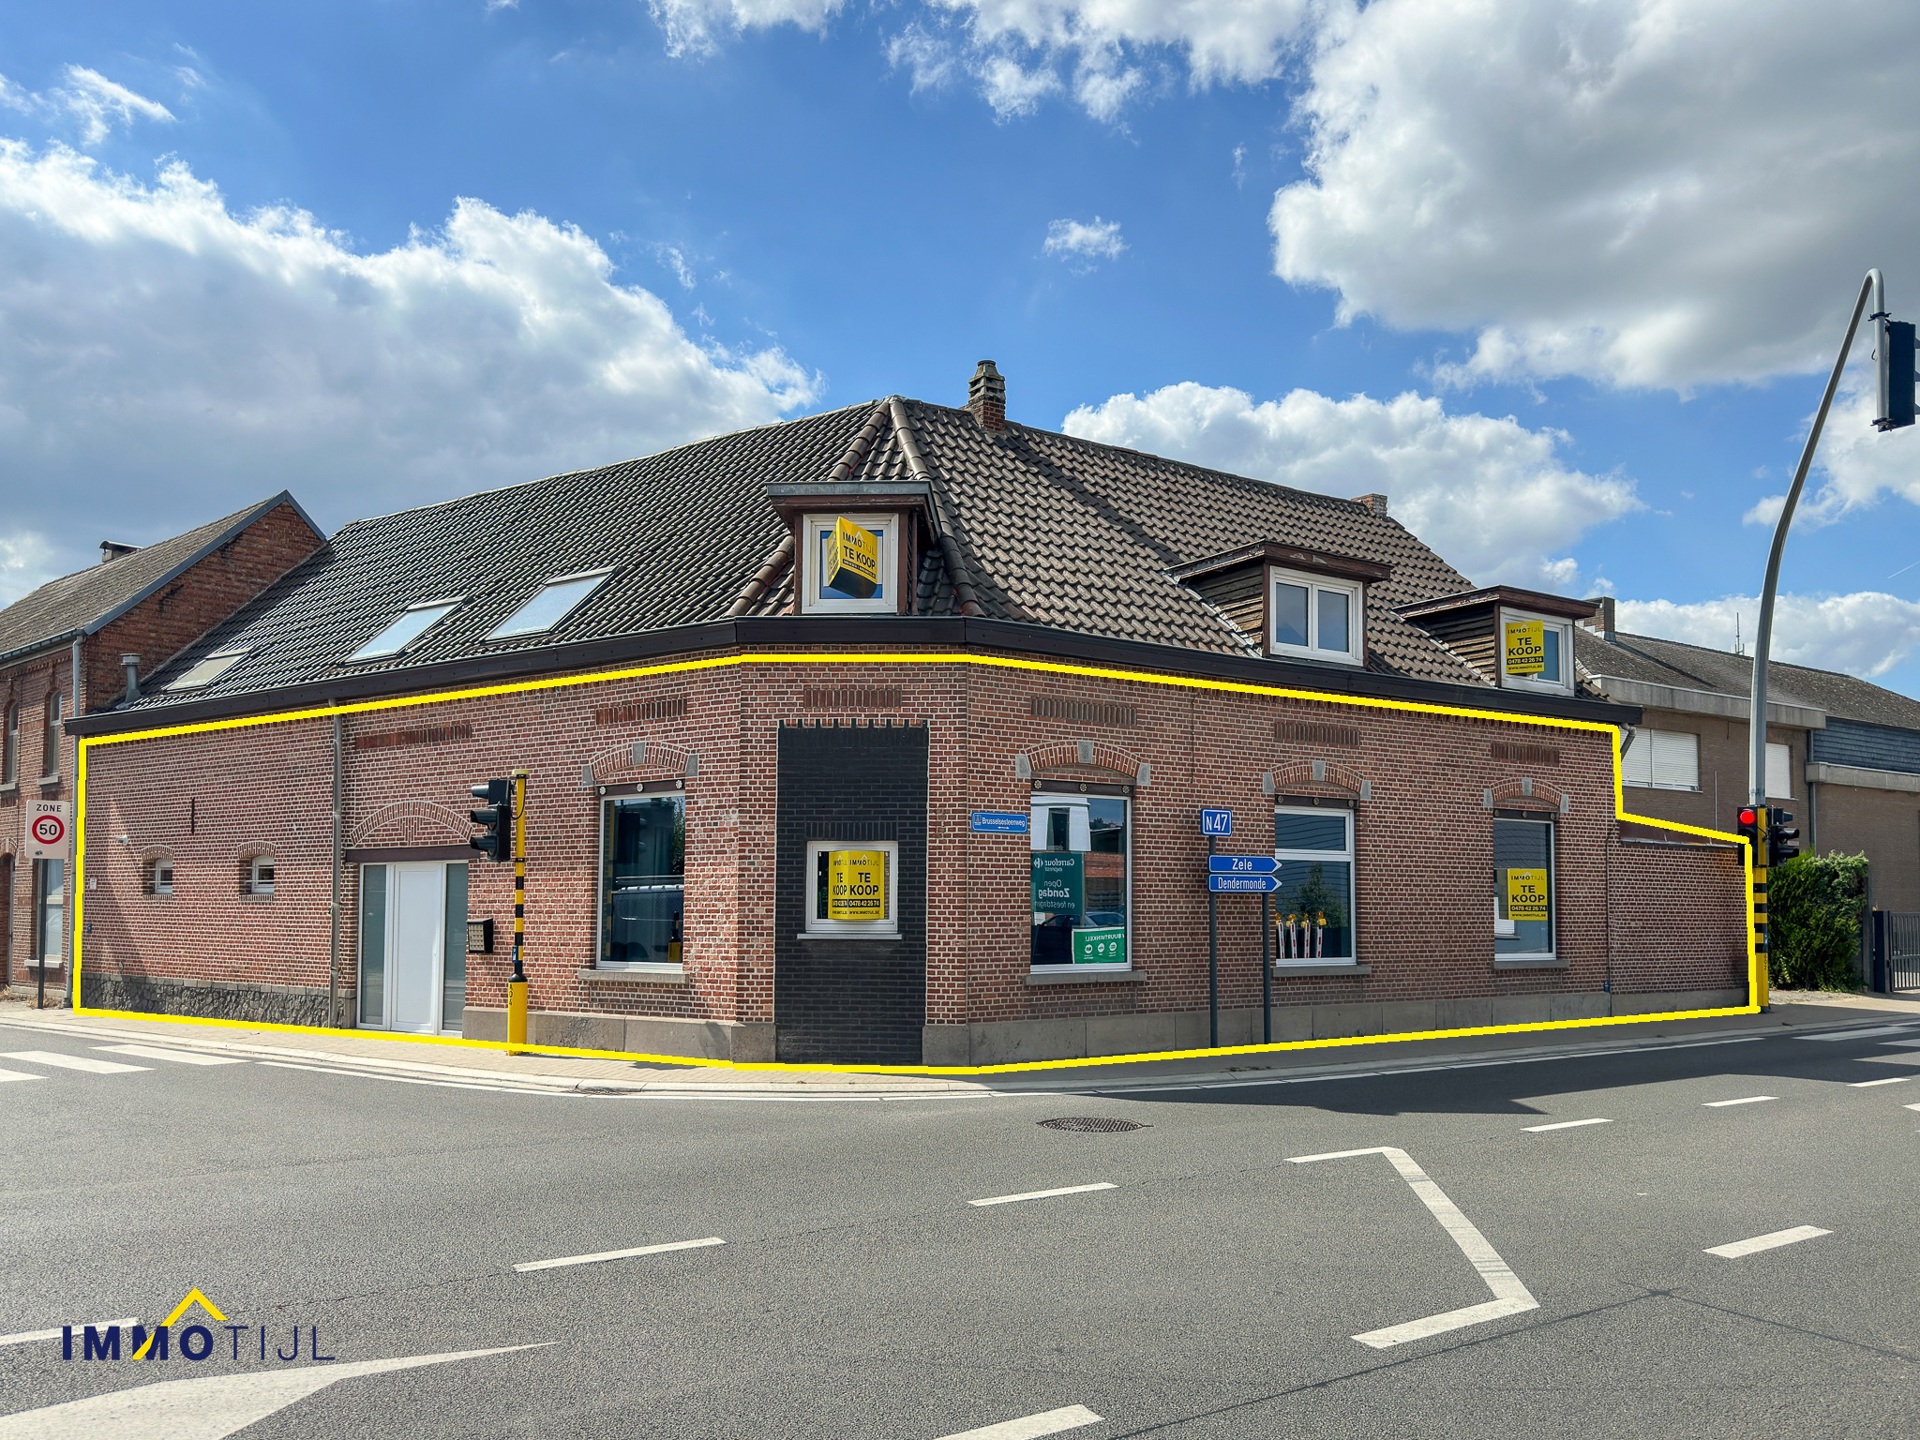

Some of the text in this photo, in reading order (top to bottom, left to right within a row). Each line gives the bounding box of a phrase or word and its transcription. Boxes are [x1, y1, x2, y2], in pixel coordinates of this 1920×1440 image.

[843, 545, 855, 560] TE
[856, 551, 876, 570] KOOP
[1517, 637, 1532, 646] TE
[1508, 646, 1542, 656] KOOP
[36, 804, 62, 812] ZONE
[39, 824, 58, 836] 50
[1232, 858, 1253, 870] Zele
[836, 872, 843, 883] TE
[857, 872, 871, 883] TE
[1218, 877, 1267, 890] Dendermonde
[1520, 884, 1536, 893] TE
[832, 884, 847, 896] KOOP
[849, 884, 879, 896] KOOP
[1511, 894, 1546, 903] KOOP
